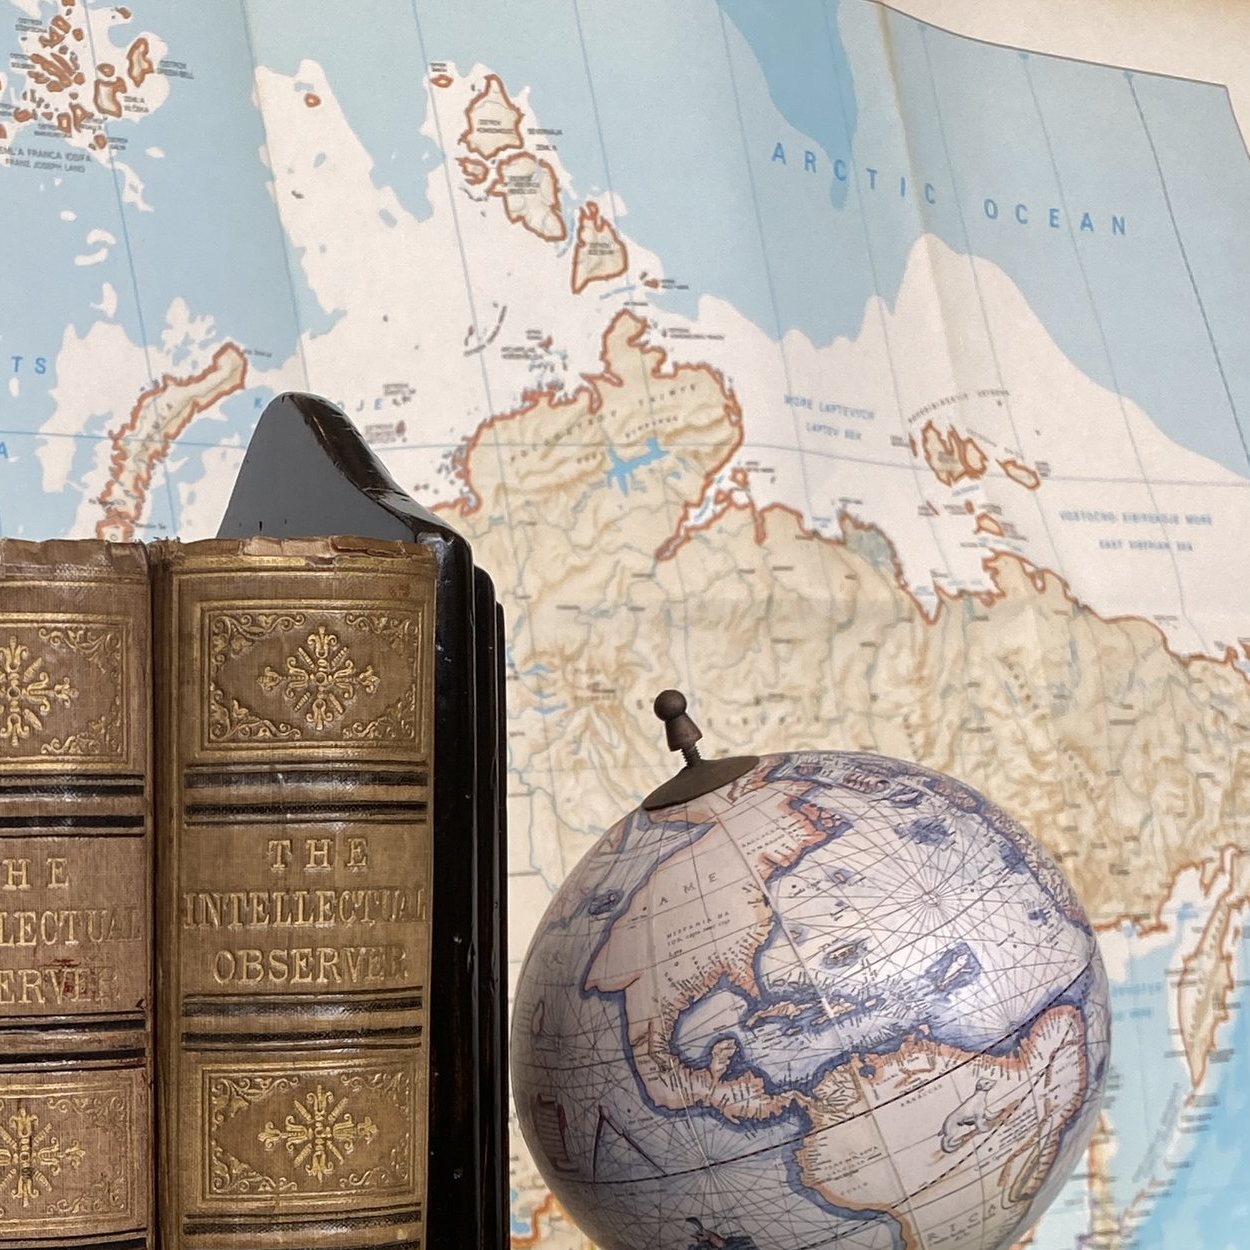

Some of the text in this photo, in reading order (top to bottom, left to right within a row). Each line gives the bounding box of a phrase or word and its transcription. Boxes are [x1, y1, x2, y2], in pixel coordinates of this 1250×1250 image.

[771, 142, 1127, 236] ARCTIC OCEAN
[268, 837, 369, 870] THE
[183, 887, 427, 929] INTELLECTUAL
[212, 945, 409, 984] OBSERVER
